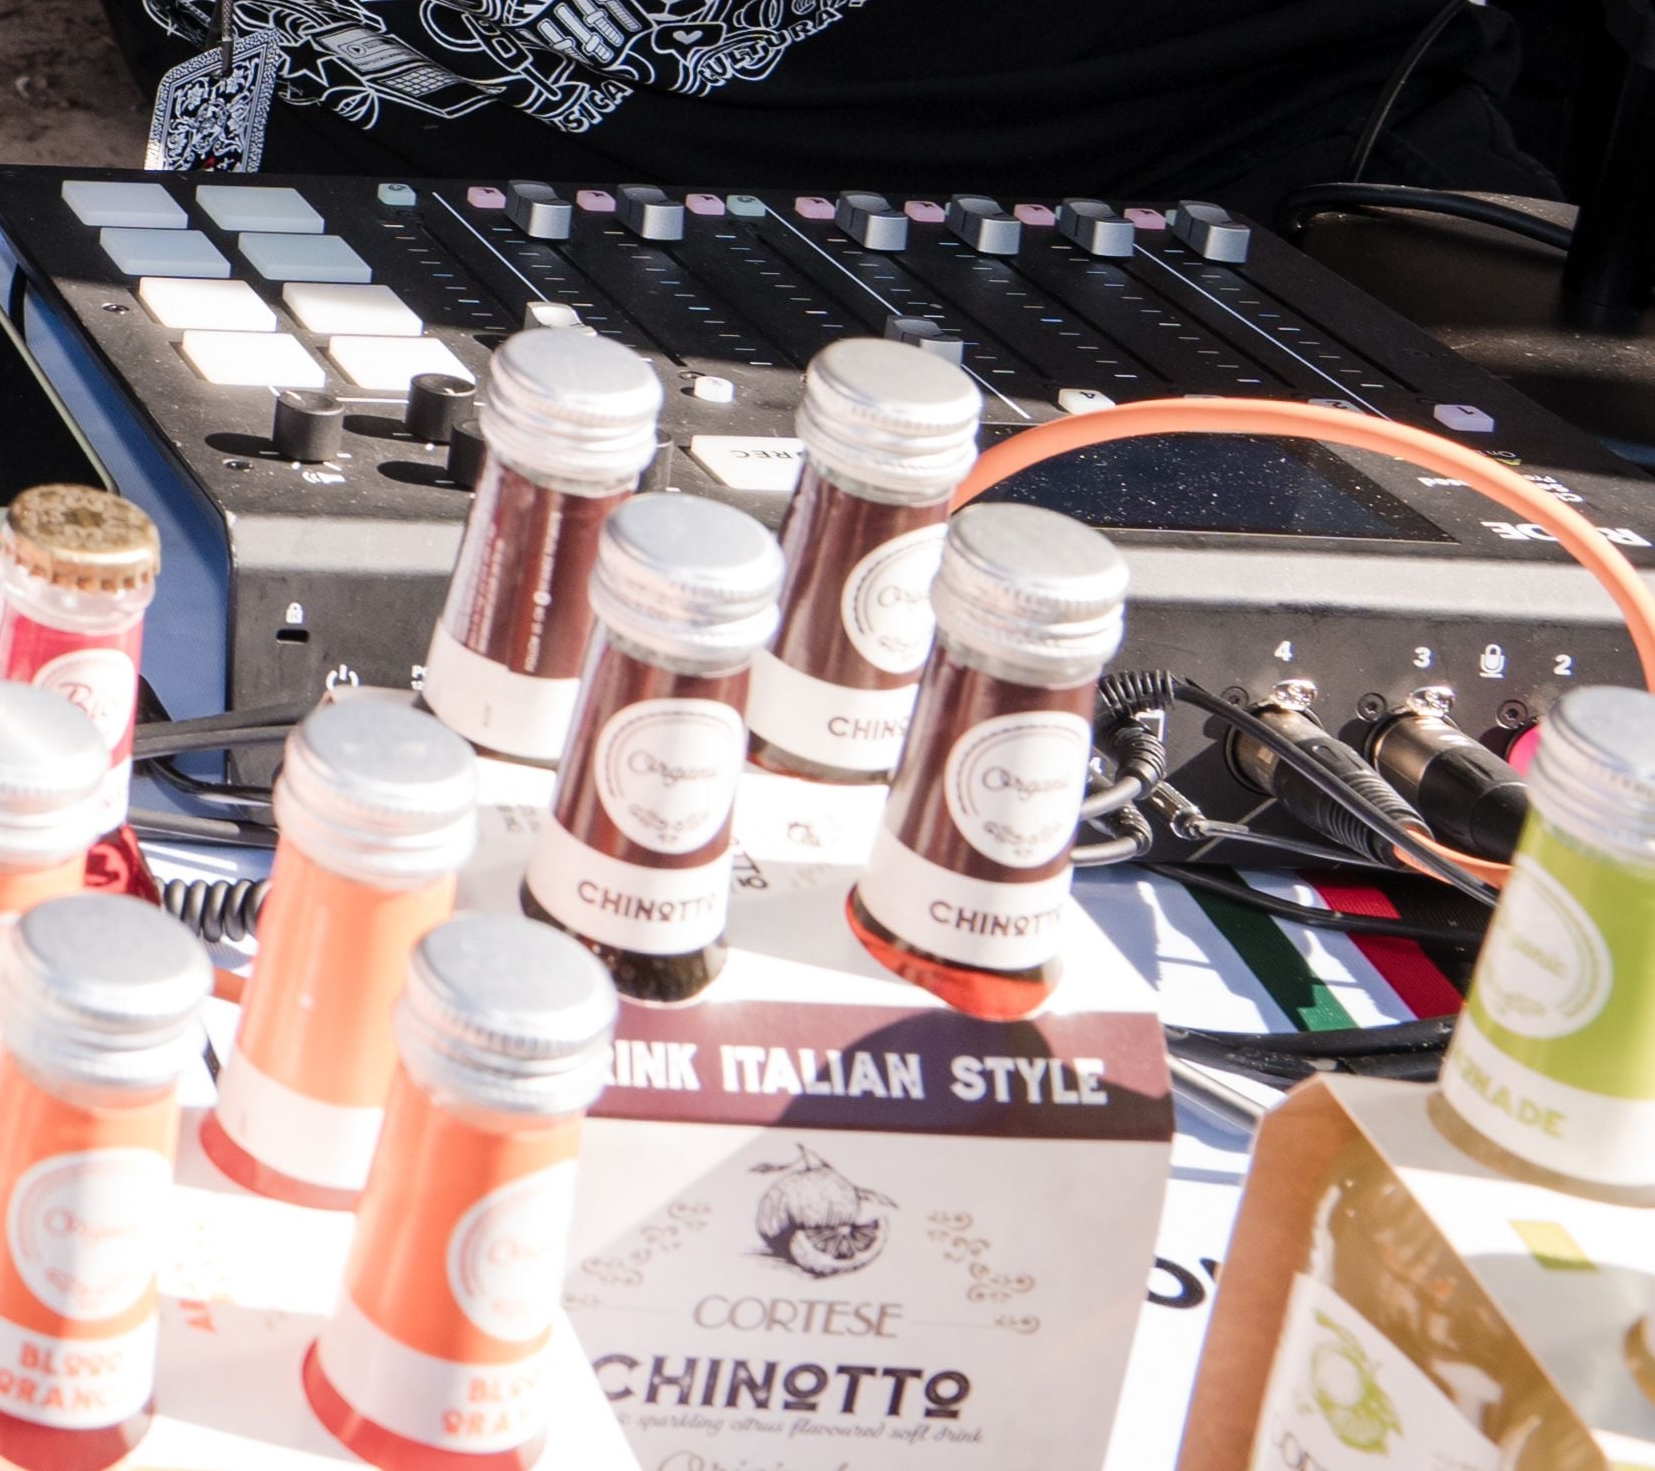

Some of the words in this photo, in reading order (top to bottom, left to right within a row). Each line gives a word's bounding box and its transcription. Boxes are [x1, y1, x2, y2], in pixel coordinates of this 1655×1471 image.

[558, 79, 635, 133] SICA
[729, 449, 793, 460] REC
[1275, 640, 1293, 662] 4
[1412, 647, 1432, 669] 3
[1553, 654, 1573, 676] 2
[605, 1041, 701, 1094] RINK
[721, 1043, 925, 1100] ITALIAN
[950, 1051, 1109, 1109] STYLE
[692, 1292, 906, 1341] CORTESE
[590, 1353, 975, 1422] CHINOTTO
